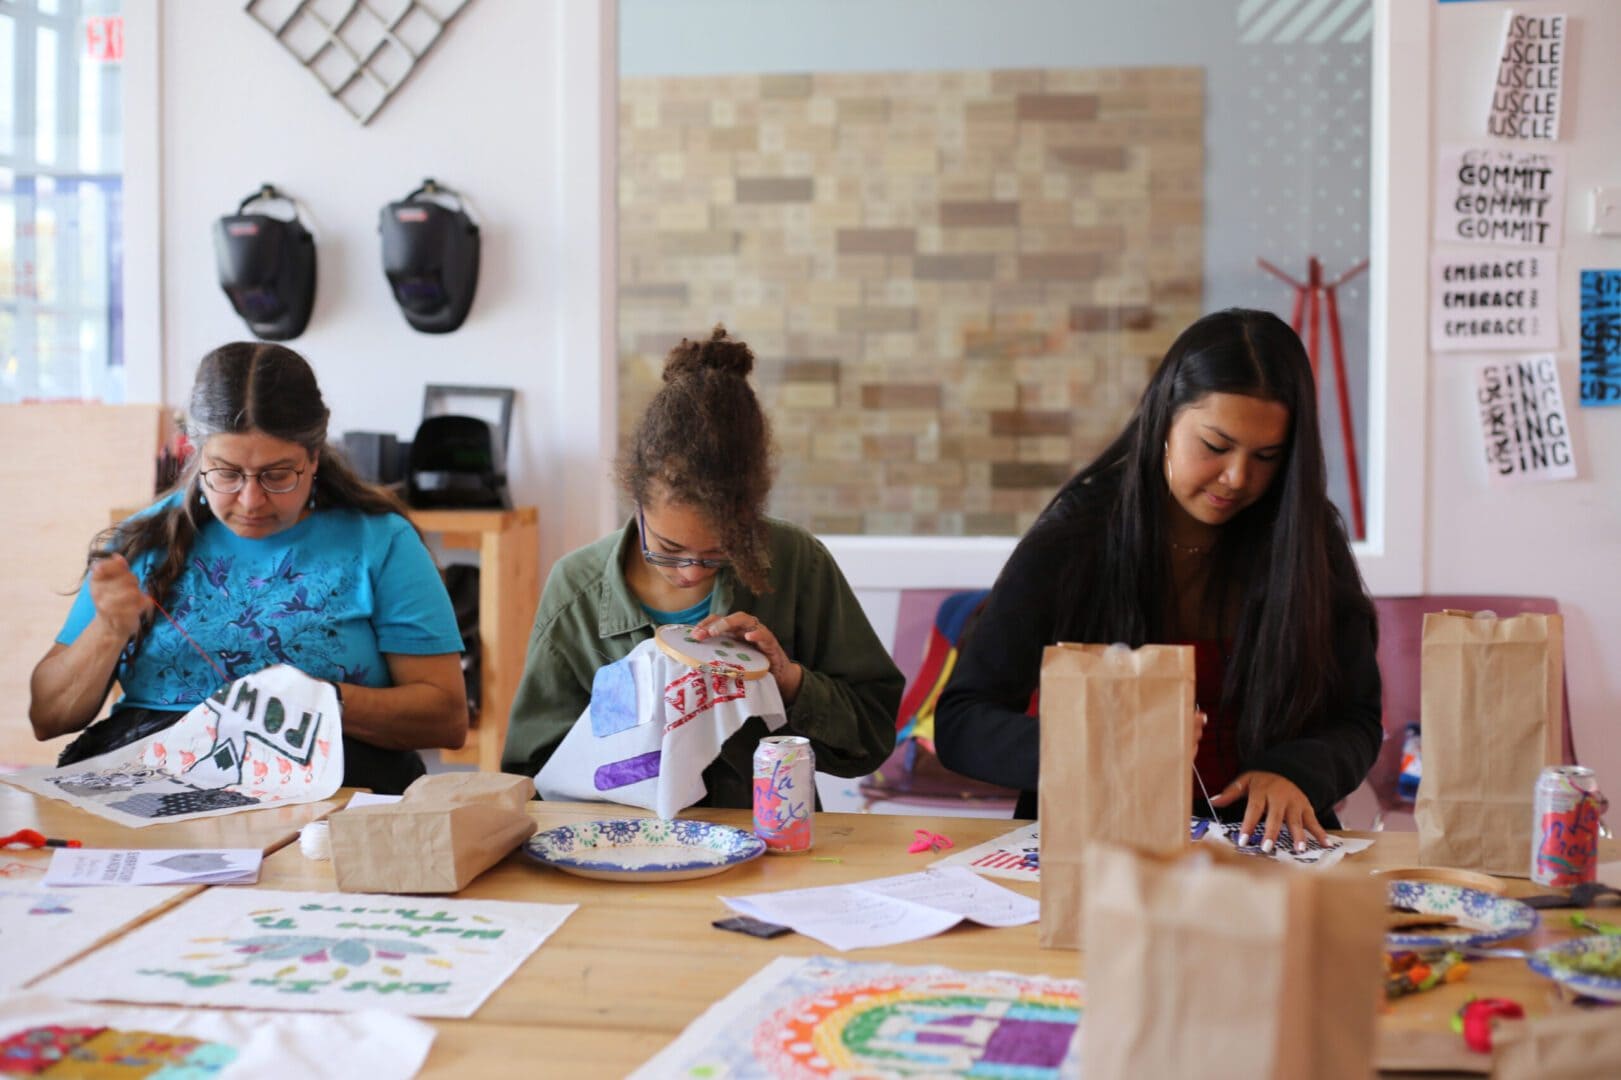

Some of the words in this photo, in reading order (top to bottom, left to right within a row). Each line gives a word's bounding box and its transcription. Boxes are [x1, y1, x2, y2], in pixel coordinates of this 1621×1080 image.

[1443, 259, 1524, 282] EMBRACE
[1443, 290, 1525, 309] EMBRACE
[767, 759, 795, 801] La
